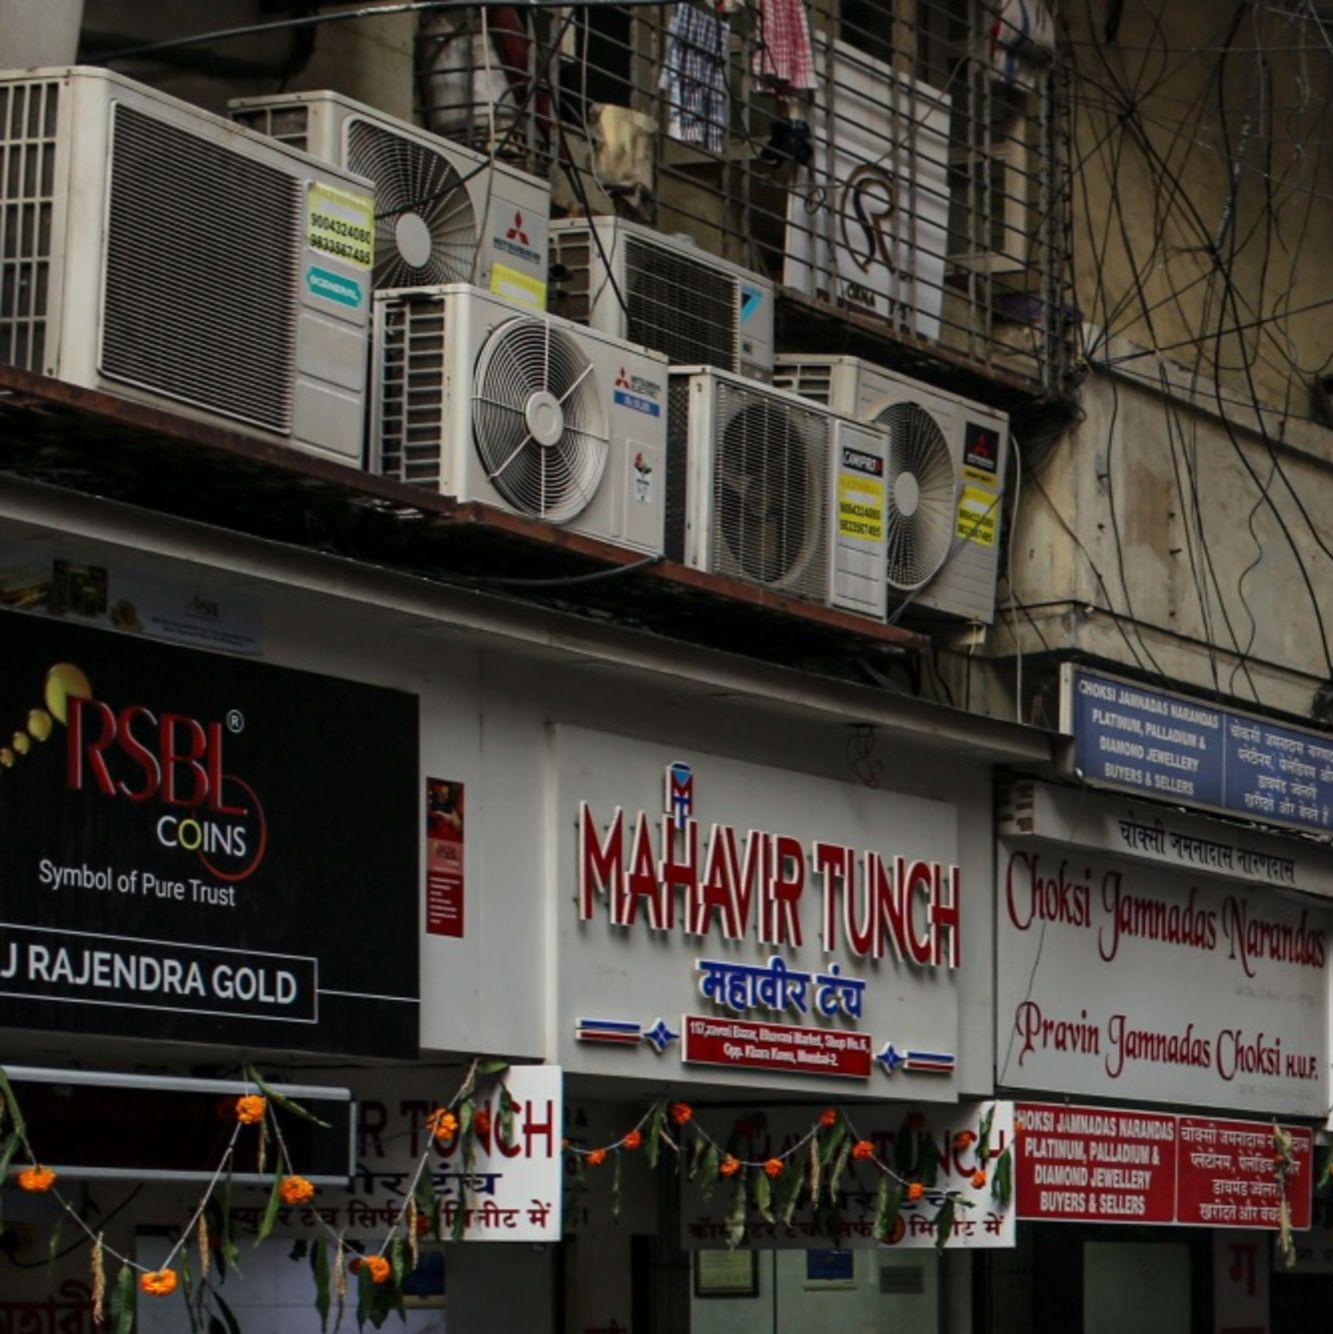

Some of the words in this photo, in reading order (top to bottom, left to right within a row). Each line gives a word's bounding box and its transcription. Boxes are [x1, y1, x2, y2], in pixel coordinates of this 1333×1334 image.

[1079, 679, 1117, 702] CHOKSI
[1117, 688, 1169, 717] JAMNADAS
[1170, 701, 1221, 729] NARANDAS
[1092, 708, 1144, 738] PLATINUM,
[1145, 721, 1198, 747] PALLADIUM
[1199, 735, 1207, 751] &
[67, 695, 247, 816] RSBL
[1100, 735, 1144, 759] DIAMOND
[1146, 745, 1200, 772] JEWELLERY
[1104, 762, 1142, 784] BUYERS
[1145, 770, 1152, 786] &
[1154, 773, 1195, 797] SELLERS
[157, 816, 247, 857] COINS
[1169, 832, 1234, 870] जमनादास
[39, 859, 112, 890] Symbol
[117, 871, 138, 893] of
[142, 873, 185, 900] Pure
[188, 879, 236, 907] Trust
[579, 801, 806, 947] MAHAVIR
[813, 841, 961, 968] TUNCH
[1006, 850, 1092, 931] Choksi
[1098, 871, 1217, 962] Jamnadas
[1224, 896, 1327, 979] Narandas
[28, 945, 206, 997] RAJENDRA
[212, 965, 298, 1004] GOLD
[696, 956, 812, 1017] महावीर
[815, 963, 867, 1020] टंच
[1015, 1001, 1100, 1068] Pravin
[1105, 1014, 1212, 1079] Jamnadas
[1216, 1029, 1281, 1081] Choksi
[1286, 1054, 1319, 1081] H.U.F.
[1057, 1112, 1117, 1138] JAMNADAS
[1119, 1118, 1174, 1142] NARANDAS
[1025, 1137, 1087, 1165] PLATINUM,
[1090, 1141, 1150, 1165] PALLADIUM
[1152, 1145, 1160, 1166] &
[1034, 1163, 1088, 1187] DIAMOND
[1090, 1167, 1152, 1191] JEWELLERY
[526, 1198, 553, 1228] में
[1040, 1191, 1086, 1213] BUYERS
[1088, 1193, 1096, 1214] &
[1100, 1193, 1146, 1216] SELLERS
[1239, 1198, 1258, 1221] और
[983, 1211, 1005, 1237] में
